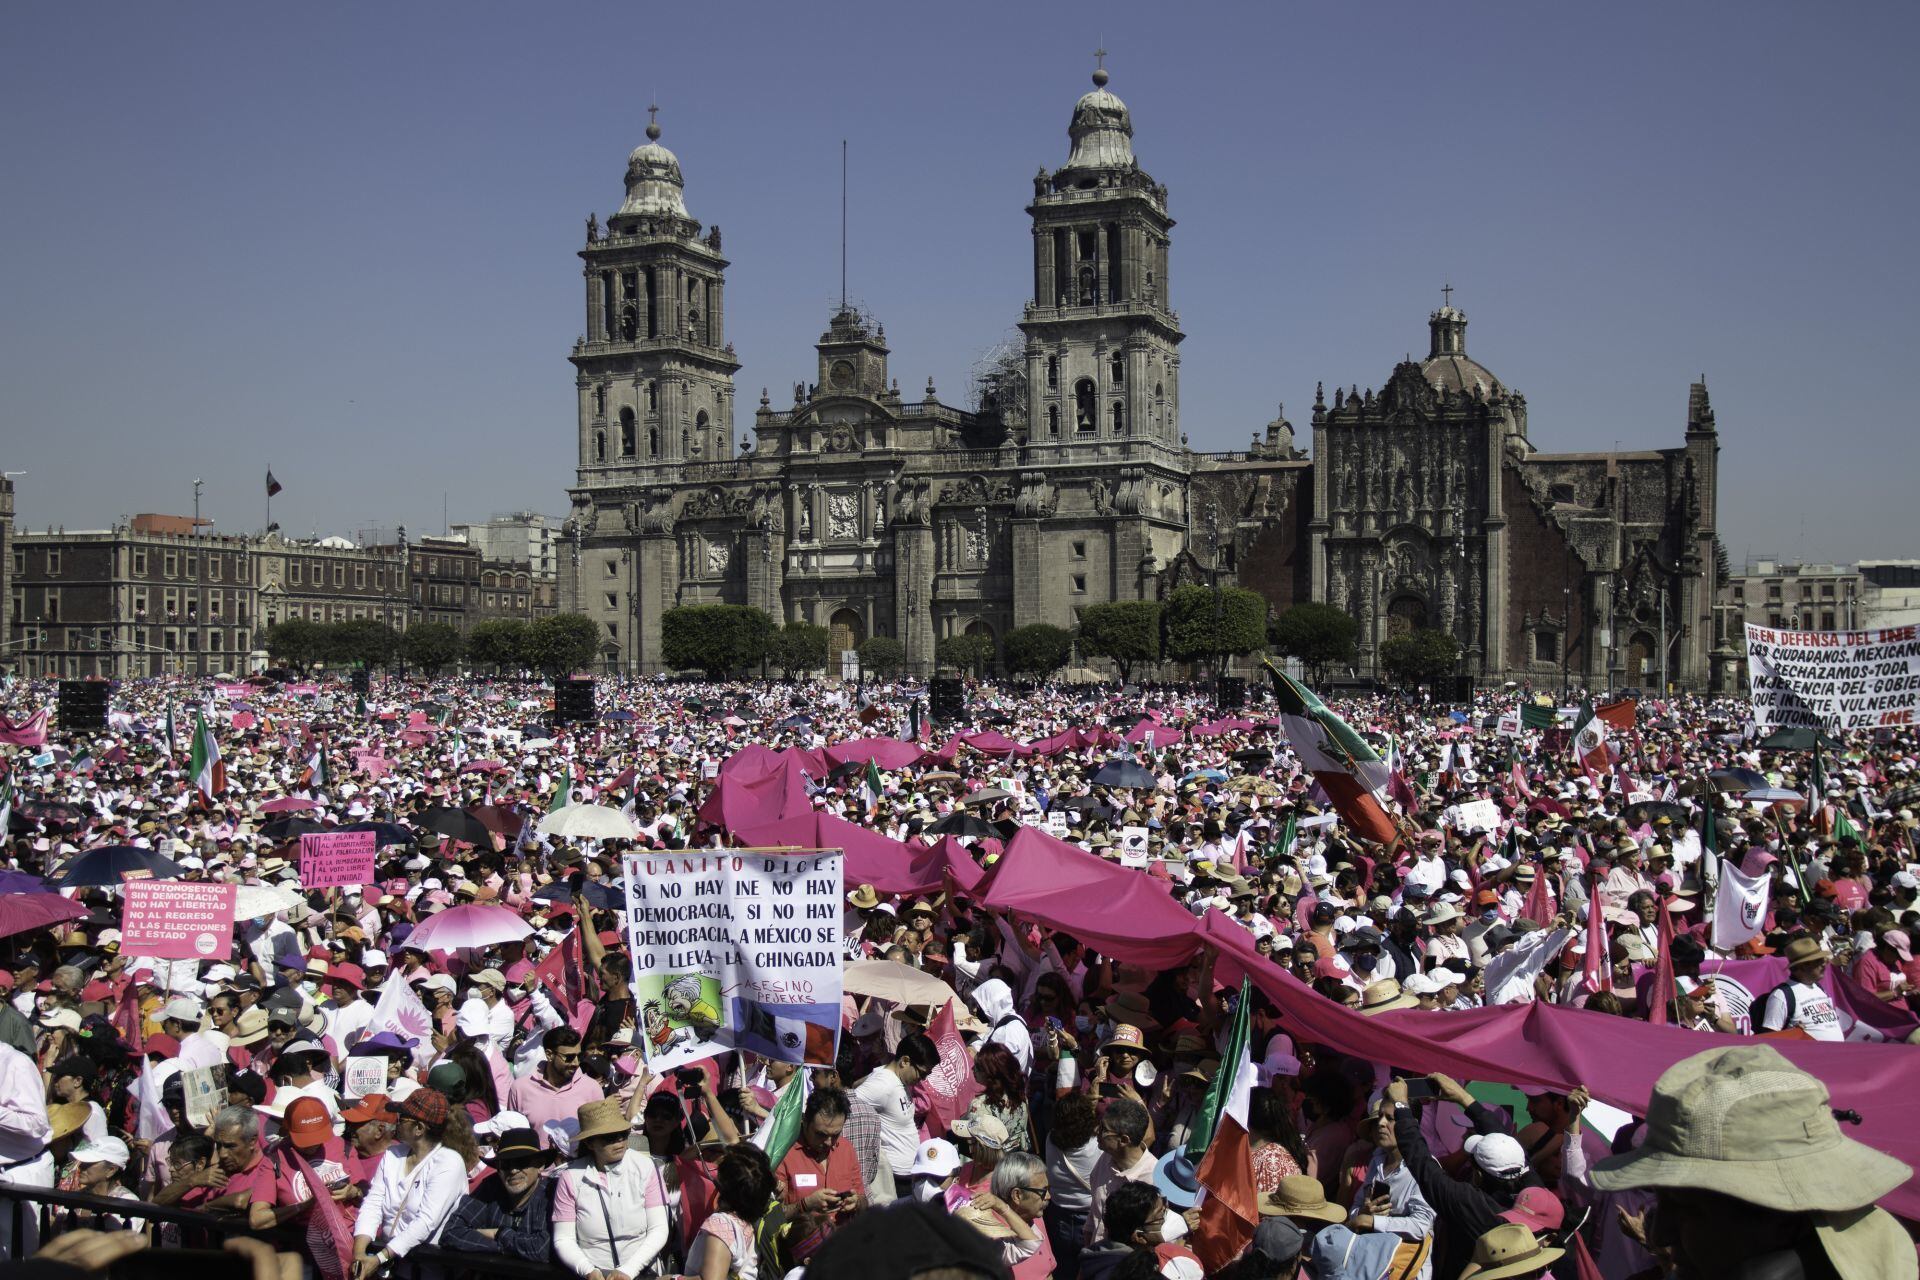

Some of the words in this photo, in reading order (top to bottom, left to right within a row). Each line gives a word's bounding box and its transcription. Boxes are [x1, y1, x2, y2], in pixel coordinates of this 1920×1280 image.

[1781, 632, 1839, 647] DEFENSA
[1844, 632, 1872, 646] DEL
[1879, 628, 1917, 644] INE
[1749, 643, 1768, 657] LOS
[1773, 662, 1868, 681] RECHAZAMOS
[1875, 661, 1909, 677] TODA
[1753, 675, 1835, 696] INJERENCIA
[1840, 680, 1867, 696] DEL
[1873, 675, 1920, 694] GOBIE
[1754, 693, 1777, 708] QUE
[1840, 693, 1915, 713] VULNERAR
[1847, 713, 1874, 728] DEL
[1879, 710, 1913, 725] INE
[303, 836, 320, 858] NO
[631, 857, 743, 876] JUANITO
[764, 857, 836, 874] DICE:
[130, 883, 228, 894] #MIVOTONOSETOCA
[131, 891, 149, 900] SIN
[152, 893, 219, 902] DEMOCRACIA
[632, 882, 647, 900] SI
[660, 882, 682, 899] NO
[695, 879, 724, 897] HAY
[736, 880, 760, 896] INE
[772, 881, 794, 896] NO
[806, 879, 837, 896] HAY
[132, 901, 147, 909] NO
[175, 902, 227, 910] LIBERTAD
[634, 903, 735, 924] DEMOCRACIA,
[747, 904, 761, 919] SI
[772, 904, 795, 919] NO
[806, 904, 837, 919] HAY
[130, 911, 145, 919] NO
[165, 912, 215, 920] REGRESO
[128, 921, 135, 929] A
[140, 922, 160, 930] LAS
[164, 922, 227, 932] ELECCIONES
[146, 931, 187, 939] ESTADO
[635, 927, 735, 947] DEMOCRACIA,
[740, 929, 749, 944] A
[754, 924, 812, 944] MÉXICO
[816, 928, 836, 943] SE
[637, 953, 656, 971] LO
[669, 950, 714, 969] LLEVA
[725, 952, 743, 966] LA
[755, 952, 837, 968] CHINGADA
[745, 979, 814, 994] ASESINO
[351, 1078, 381, 1086] NOSETOCA
